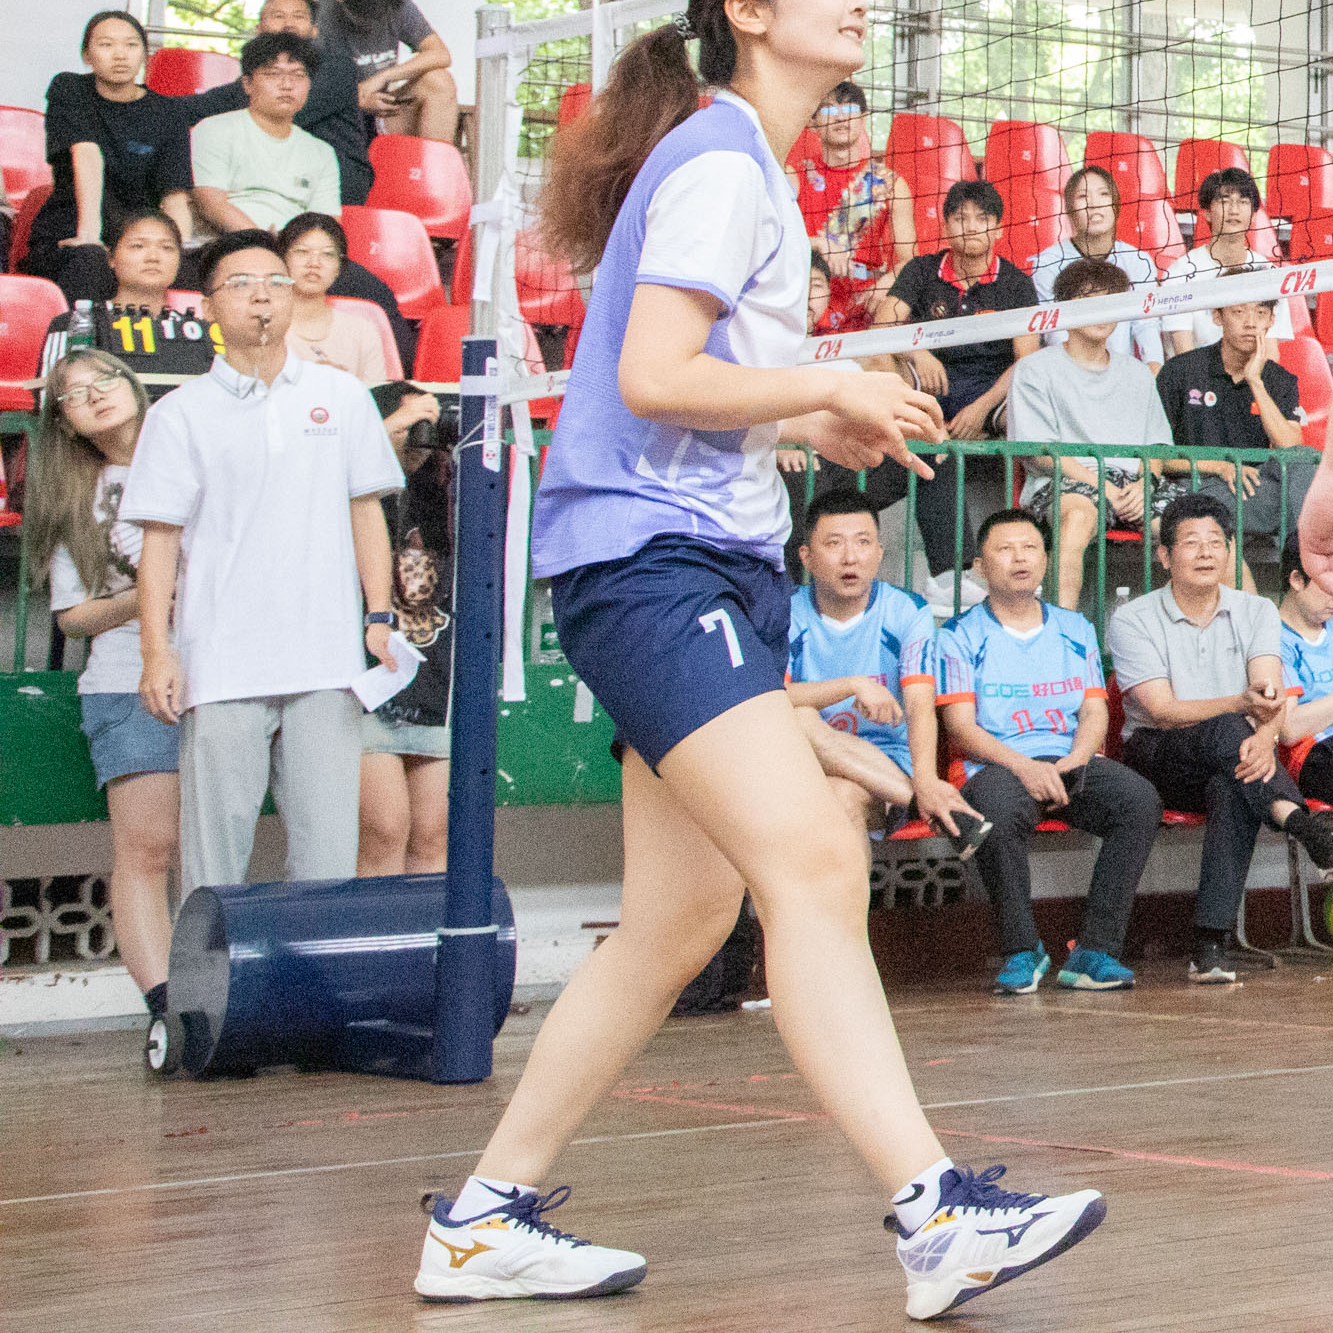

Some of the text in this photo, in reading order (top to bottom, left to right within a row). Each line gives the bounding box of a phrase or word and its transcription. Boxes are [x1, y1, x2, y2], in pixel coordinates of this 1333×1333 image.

[1280, 268, 1317, 294] CVA
[1028, 308, 1060, 332] CVA
[112, 316, 156, 353] 11
[815, 339, 842, 360] CVA
[698, 608, 745, 669] 7
[1032, 676, 1083, 697] 好口语
[1011, 709, 1067, 734] 11
